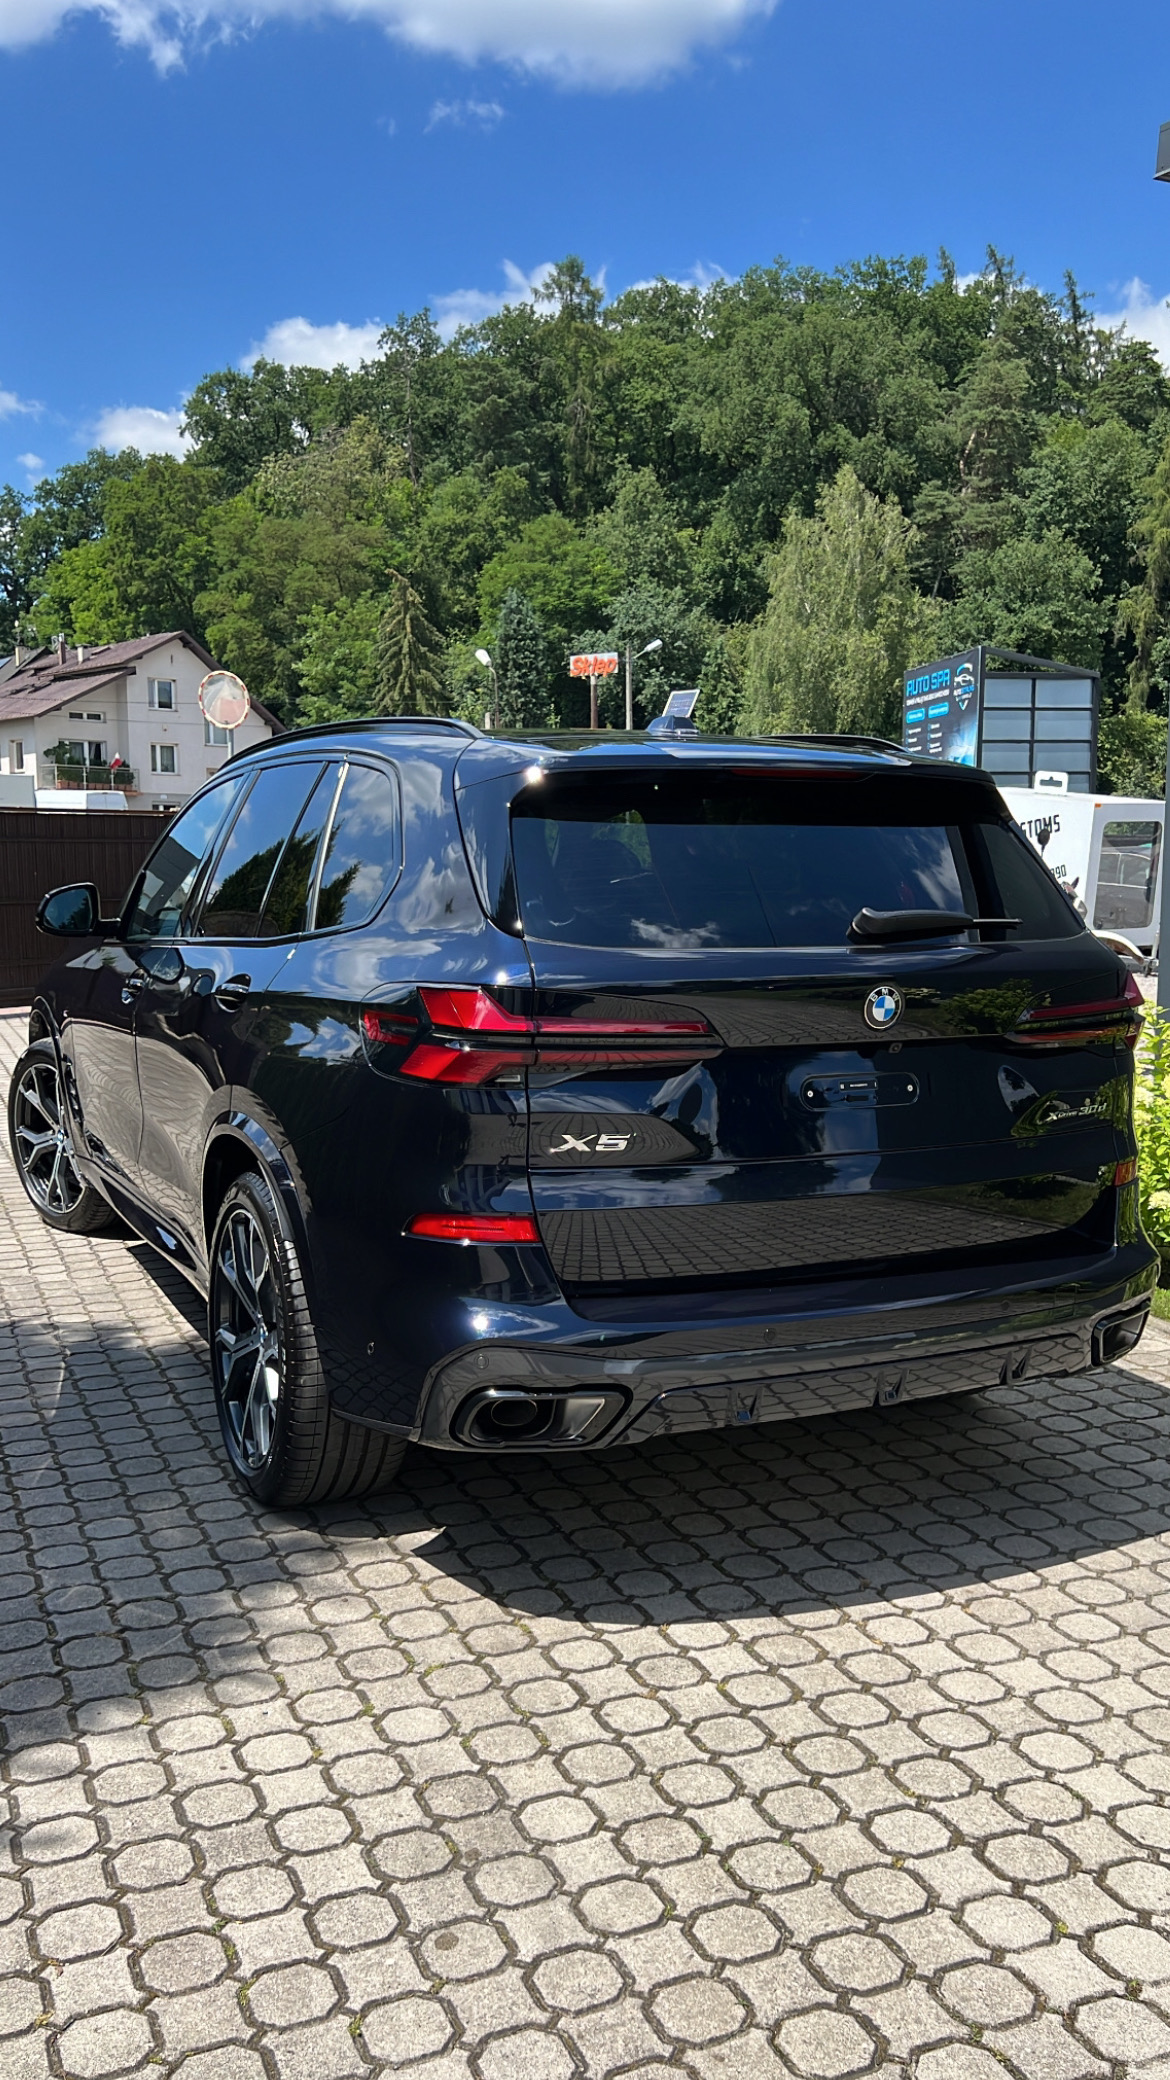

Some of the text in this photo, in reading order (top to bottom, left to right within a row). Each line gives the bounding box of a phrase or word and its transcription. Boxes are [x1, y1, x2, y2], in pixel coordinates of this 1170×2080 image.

[570, 656, 618, 677] Sklep
[906, 675, 929, 697] AUTO
[931, 668, 950, 690] SPA
[870, 988, 900, 1002] BMW
[549, 1133, 631, 1152] X5
